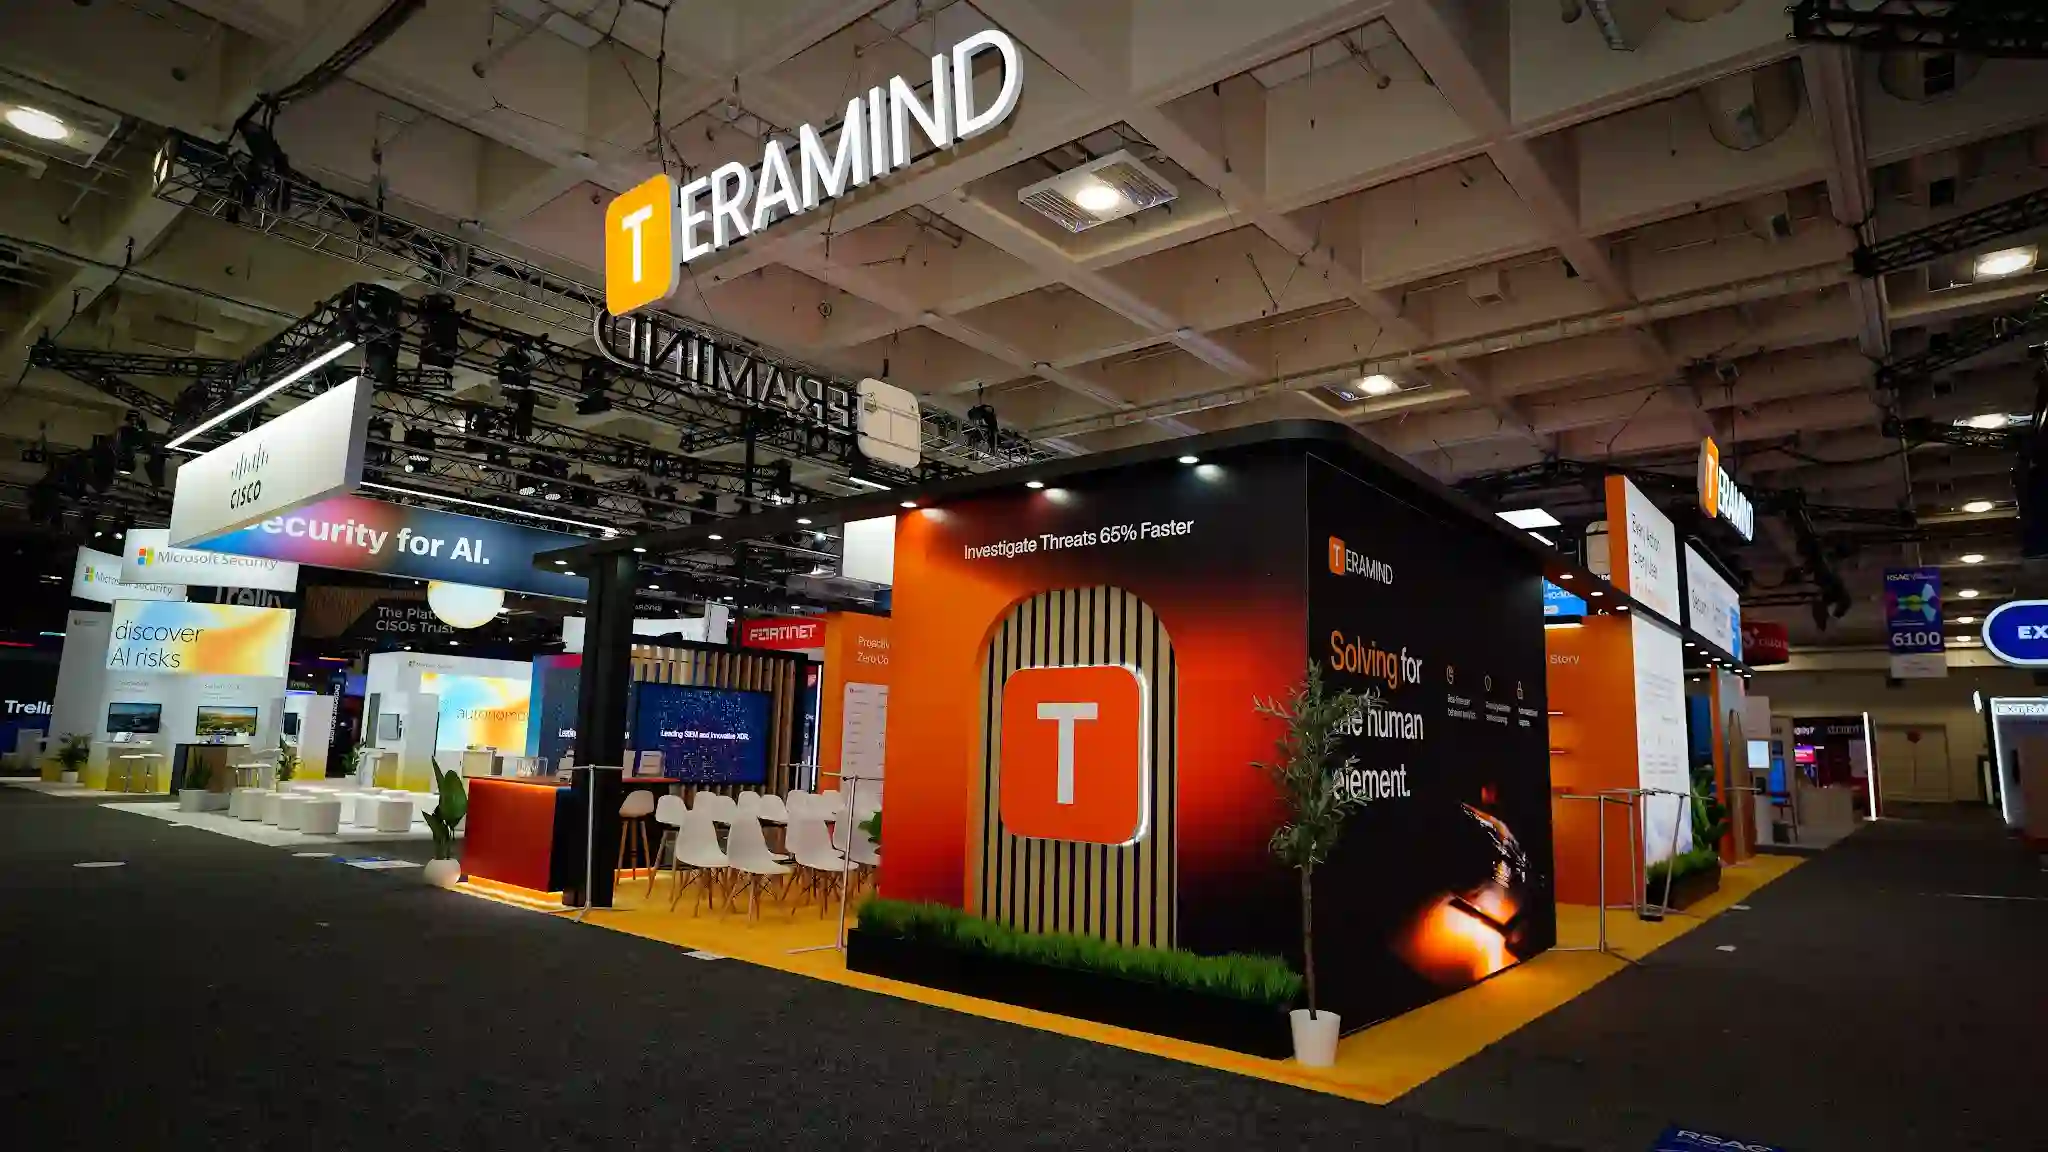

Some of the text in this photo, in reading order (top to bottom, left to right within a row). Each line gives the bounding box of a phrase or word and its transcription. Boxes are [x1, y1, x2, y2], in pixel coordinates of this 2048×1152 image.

[396, 527, 444, 557] for
[449, 537, 490, 565] AI.
[964, 518, 1195, 560] Investigate Threats 65% Faster
[1333, 544, 1394, 585] TERAMIND
[378, 606, 436, 620] The Plat
[115, 620, 204, 643] discover
[376, 619, 416, 633] CISOs
[750, 624, 817, 642] FORTINET
[1892, 632, 1941, 647] 6100
[110, 648, 181, 669] AI risks
[1331, 630, 1423, 690] Solving for
[1549, 653, 1580, 666] Story
[1367, 700, 1424, 740] human
[1037, 702, 1099, 805] T
